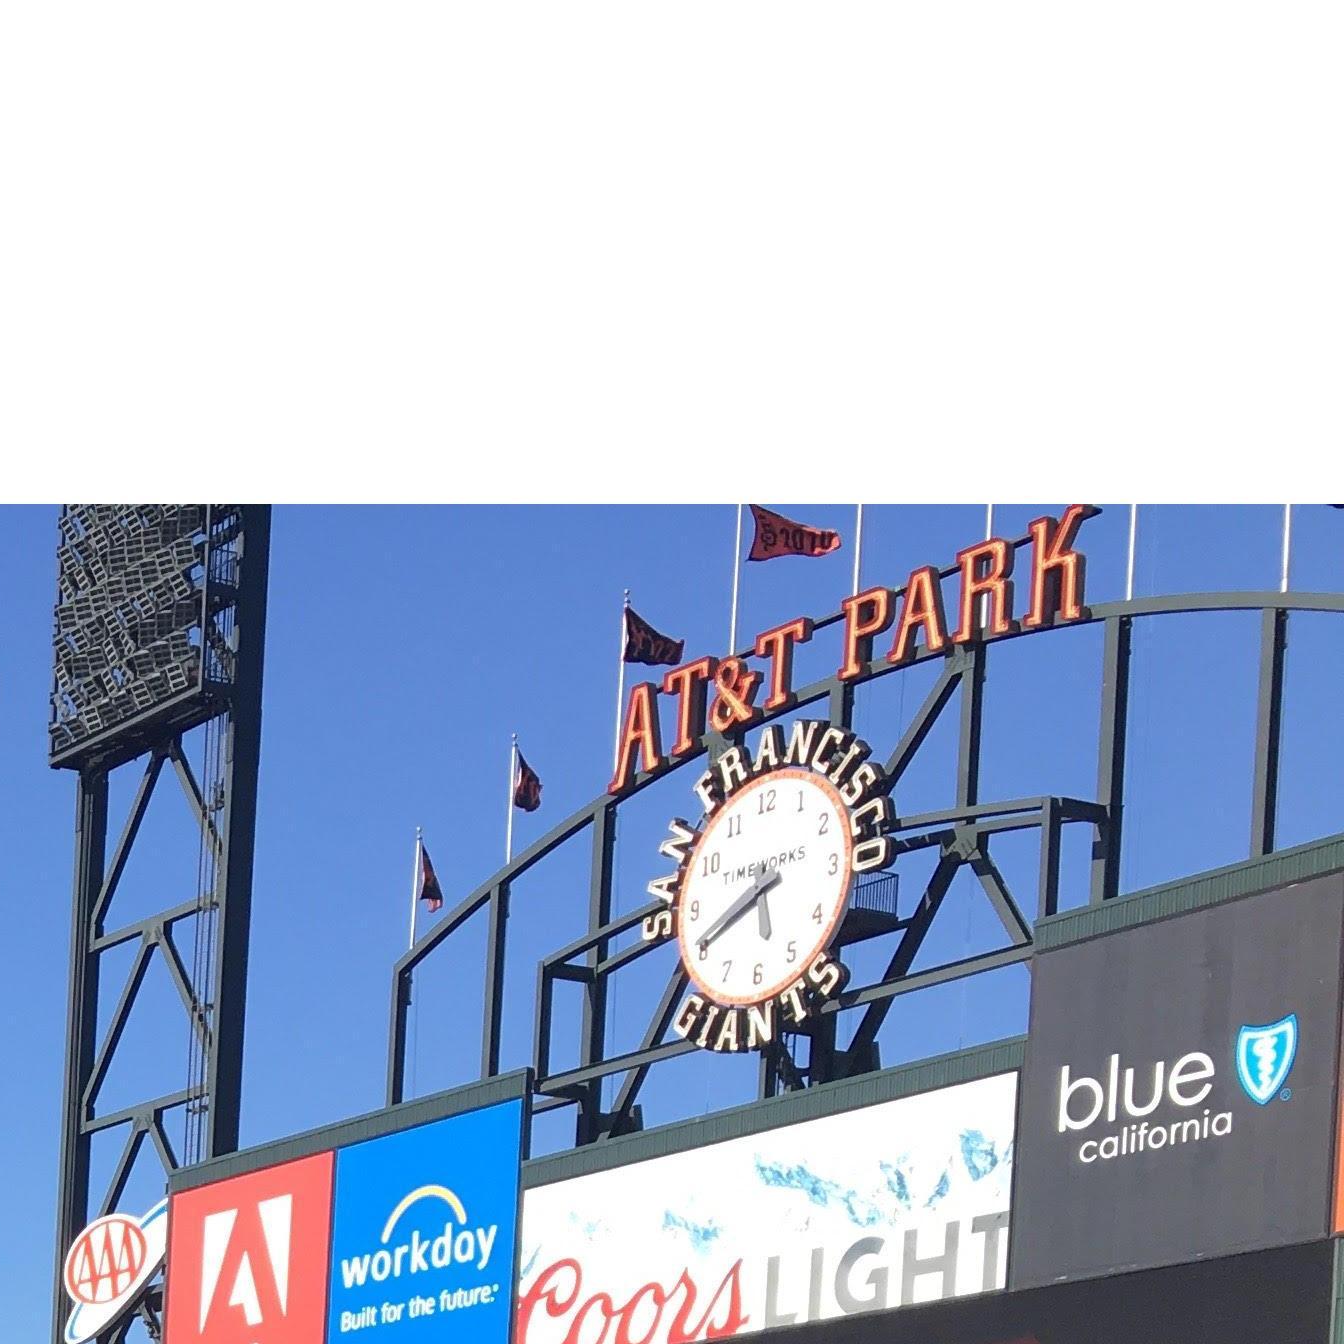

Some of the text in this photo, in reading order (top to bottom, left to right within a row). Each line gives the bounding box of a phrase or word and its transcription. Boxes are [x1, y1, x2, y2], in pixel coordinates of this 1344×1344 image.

[609, 503, 1100, 795] AT&T PARK
[693, 720, 888, 875] FRANCISCO
[757, 790, 776, 814] 12
[727, 815, 742, 837] 11
[818, 813, 829, 835] 2
[642, 818, 696, 942] SAN
[702, 853, 720, 877] 10
[723, 846, 806, 885] TIMEWORKS
[828, 854, 838, 876] 3
[690, 901, 700, 921] 9
[812, 903, 822, 924] 4
[786, 942, 796, 963] 5
[722, 961, 732, 983] 7
[753, 964, 763, 984] 6
[673, 953, 840, 1051] GIANTS
[1058, 1051, 1215, 1133] blue
[1079, 1109, 1233, 1163] california
[77, 1222, 138, 1302] AAA
[341, 1222, 498, 1289] workday
[764, 1211, 1009, 1330] LIGHT
[340, 1308, 377, 1333] Built
[381, 1300, 404, 1325] for
[408, 1296, 435, 1319] the
